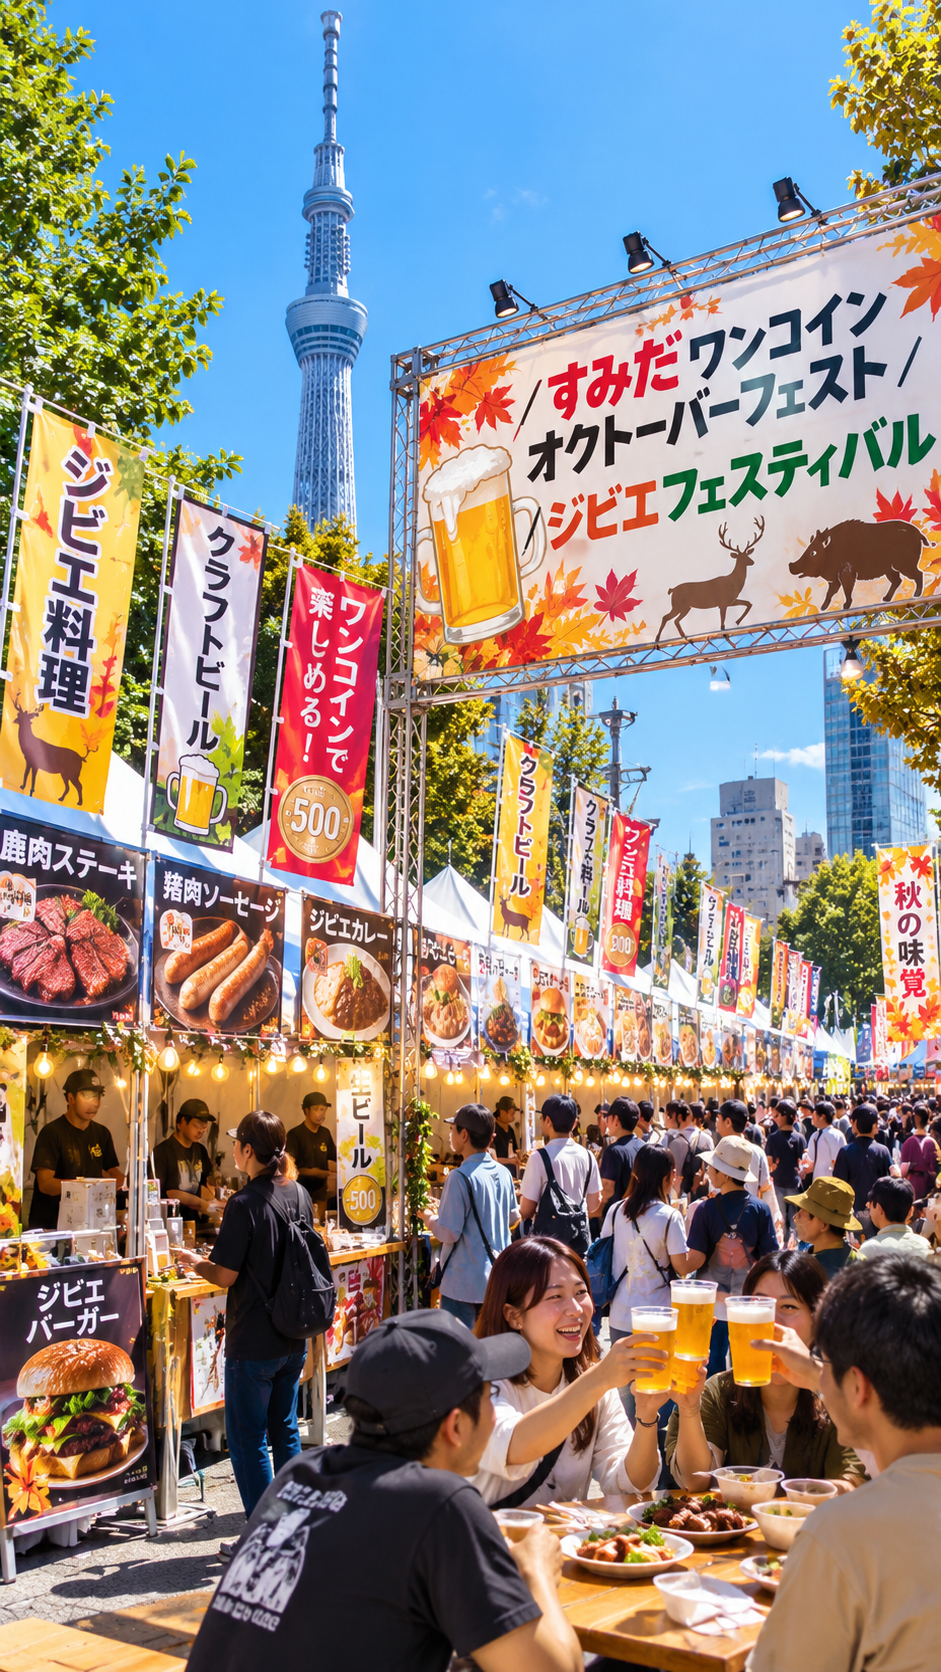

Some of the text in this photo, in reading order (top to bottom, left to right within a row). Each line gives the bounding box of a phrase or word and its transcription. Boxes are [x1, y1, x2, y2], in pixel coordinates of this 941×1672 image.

[527, 346, 887, 483] オクトーバーフェスト
[36, 447, 113, 717] ジビエ料理
[186, 526, 235, 751] クラフトビール
[326, 595, 367, 773] ワンコインで
[291, 797, 341, 840] 500
[0, 829, 137, 889] 鹿肉ステーキ
[163, 870, 281, 922] 猪肉ソーセージ
[309, 908, 388, 943] ジビエカレー
[894, 879, 927, 999] 秋の味覚
[351, 1071, 372, 1170] 生ビール
[26, 1306, 119, 1344] バーガー
[37, 1279, 105, 1313] ジビエ
